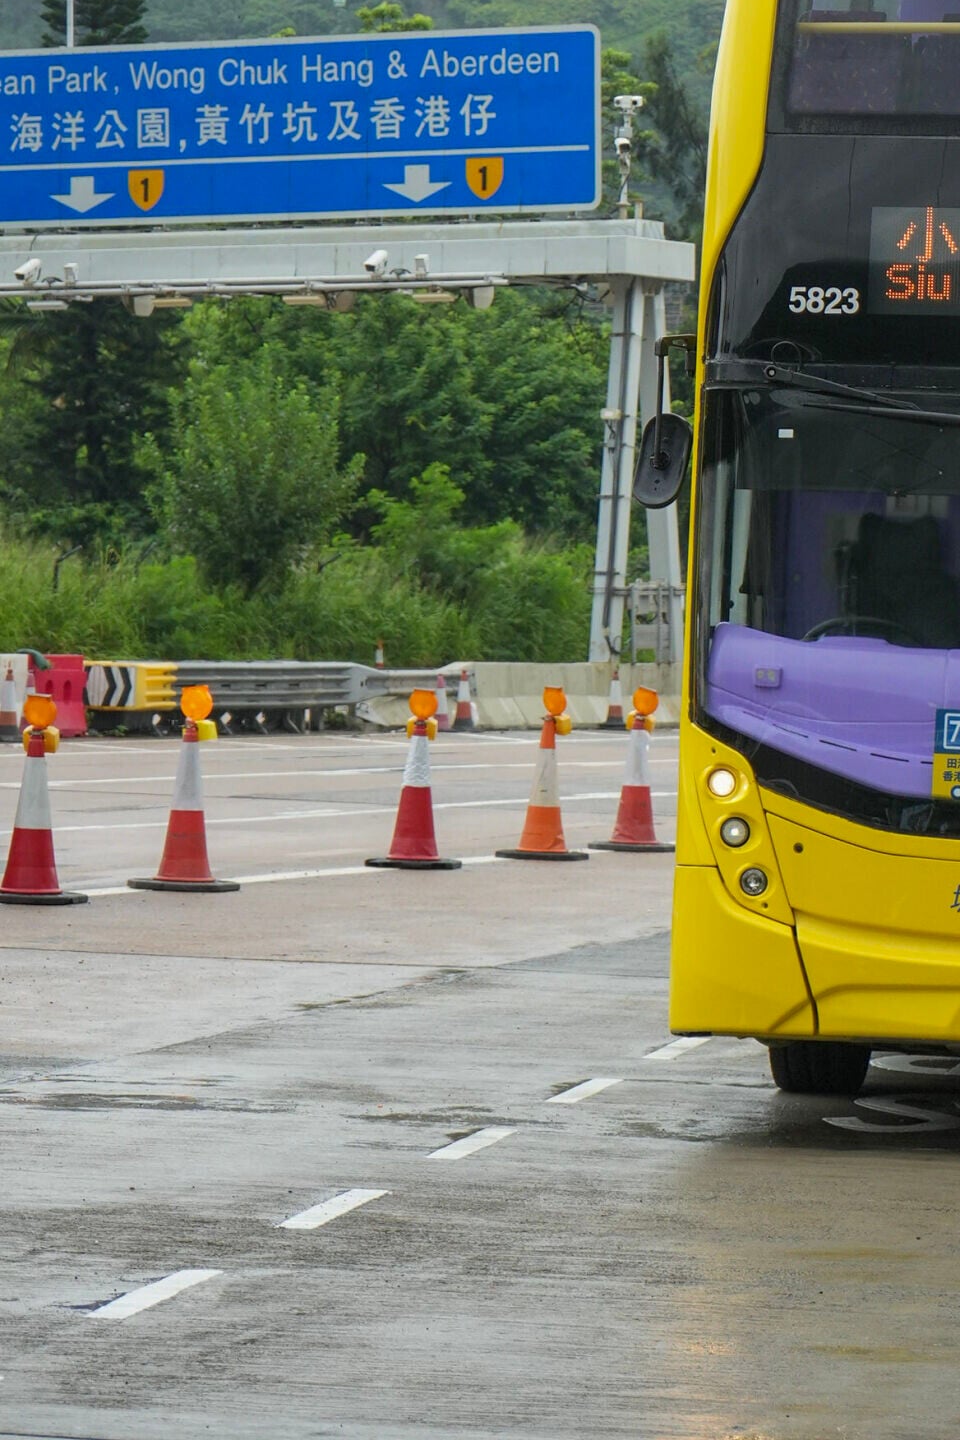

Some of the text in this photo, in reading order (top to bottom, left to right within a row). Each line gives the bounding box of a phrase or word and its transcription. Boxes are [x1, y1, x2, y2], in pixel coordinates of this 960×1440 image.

[0, 49, 560, 95] an Park, Wong Chuk Hang & Aberdeen
[139, 177, 150, 202] 1
[477, 165, 488, 191] 1
[884, 264, 951, 301] Siu
[788, 287, 860, 315] 5823
